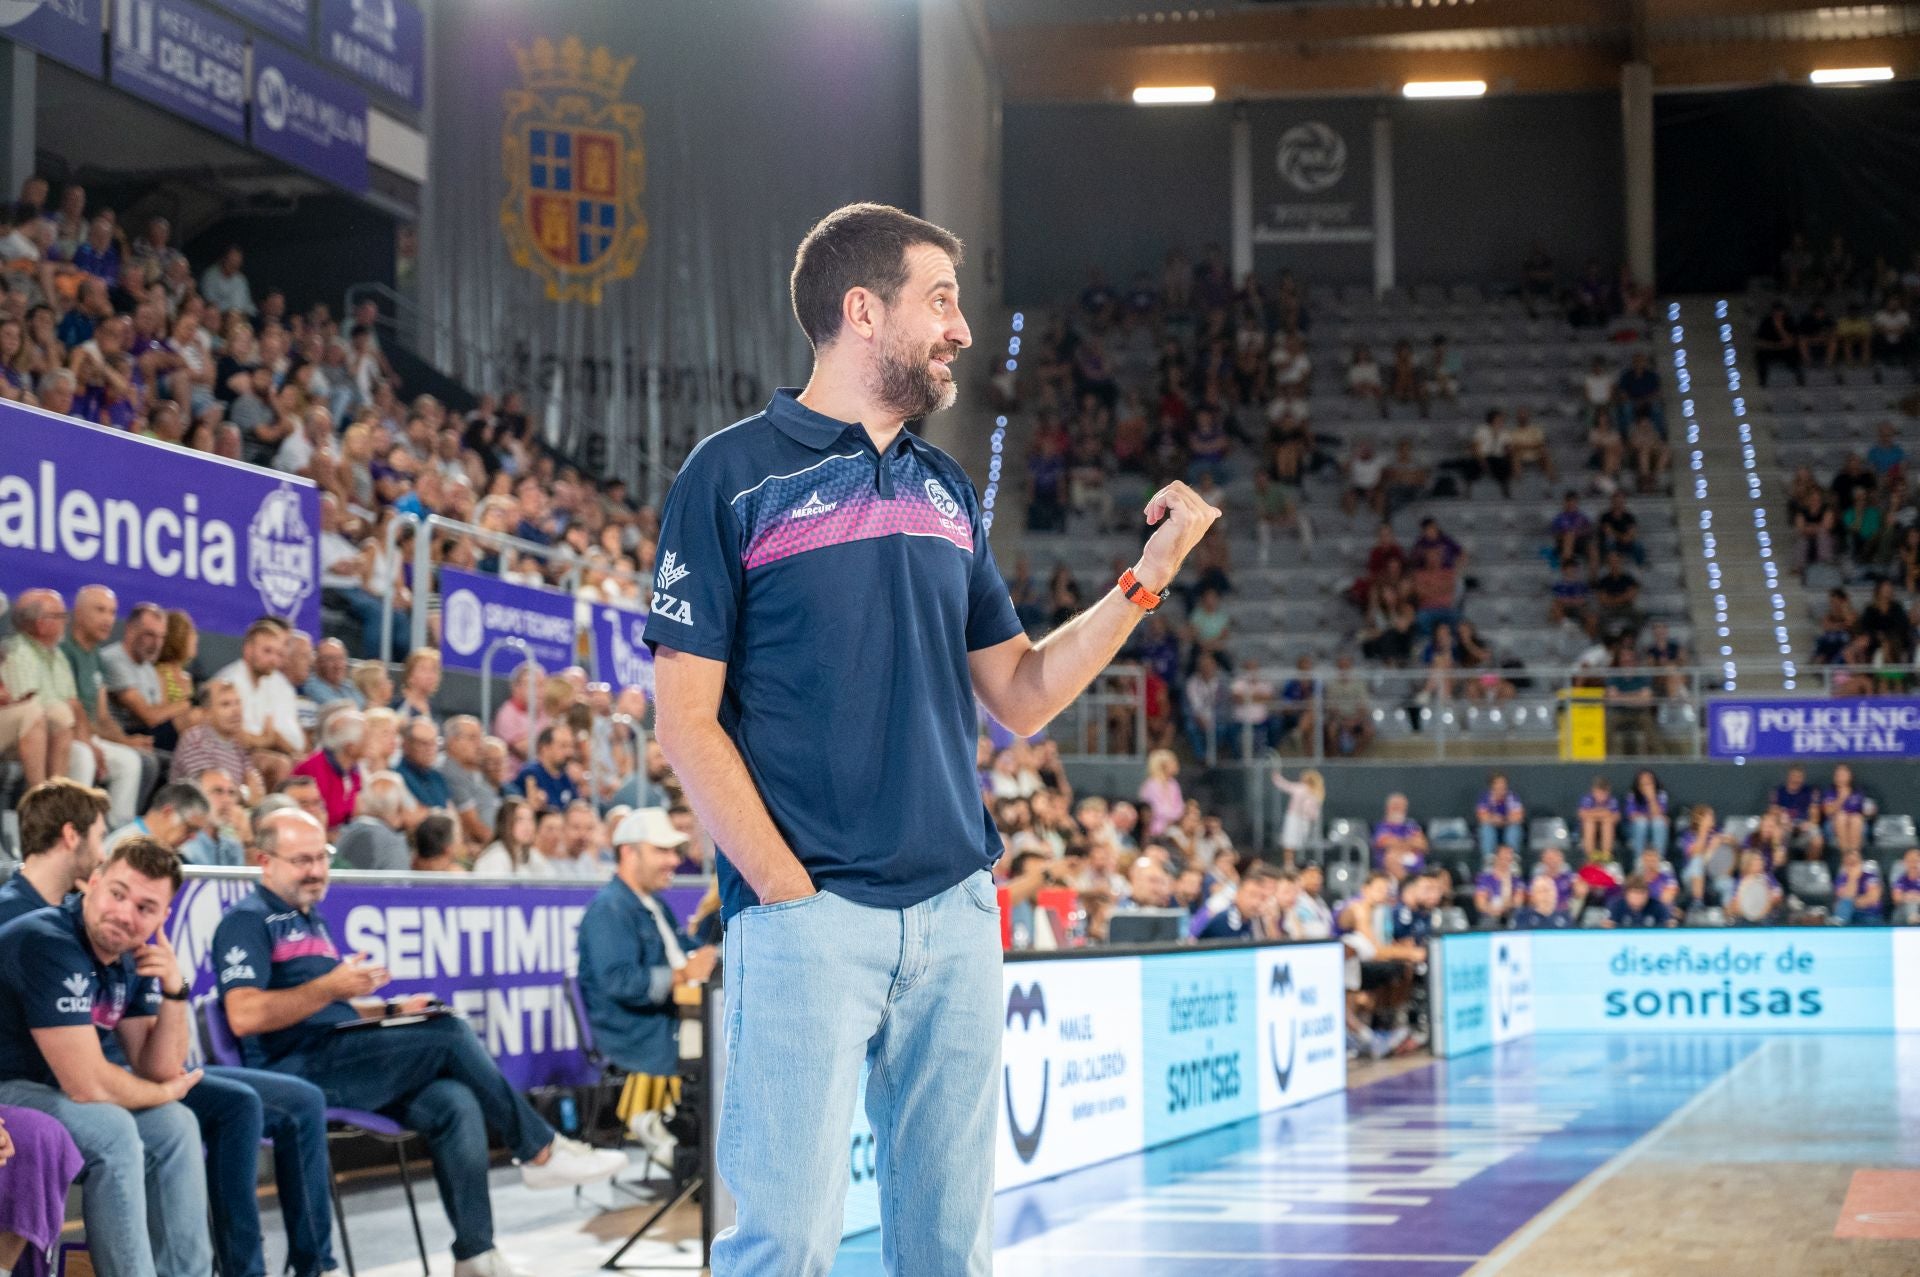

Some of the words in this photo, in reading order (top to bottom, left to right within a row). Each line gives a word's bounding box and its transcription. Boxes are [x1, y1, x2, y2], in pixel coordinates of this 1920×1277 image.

[0, 459, 237, 587] alencia
[792, 501, 838, 519] MERCURY
[1758, 701, 1920, 732] POLICLÍNIC
[1793, 727, 1904, 753] DENTAL
[1610, 945, 1763, 976] diseñador
[1776, 944, 1815, 974] de
[1604, 980, 1824, 1018] sonrisas
